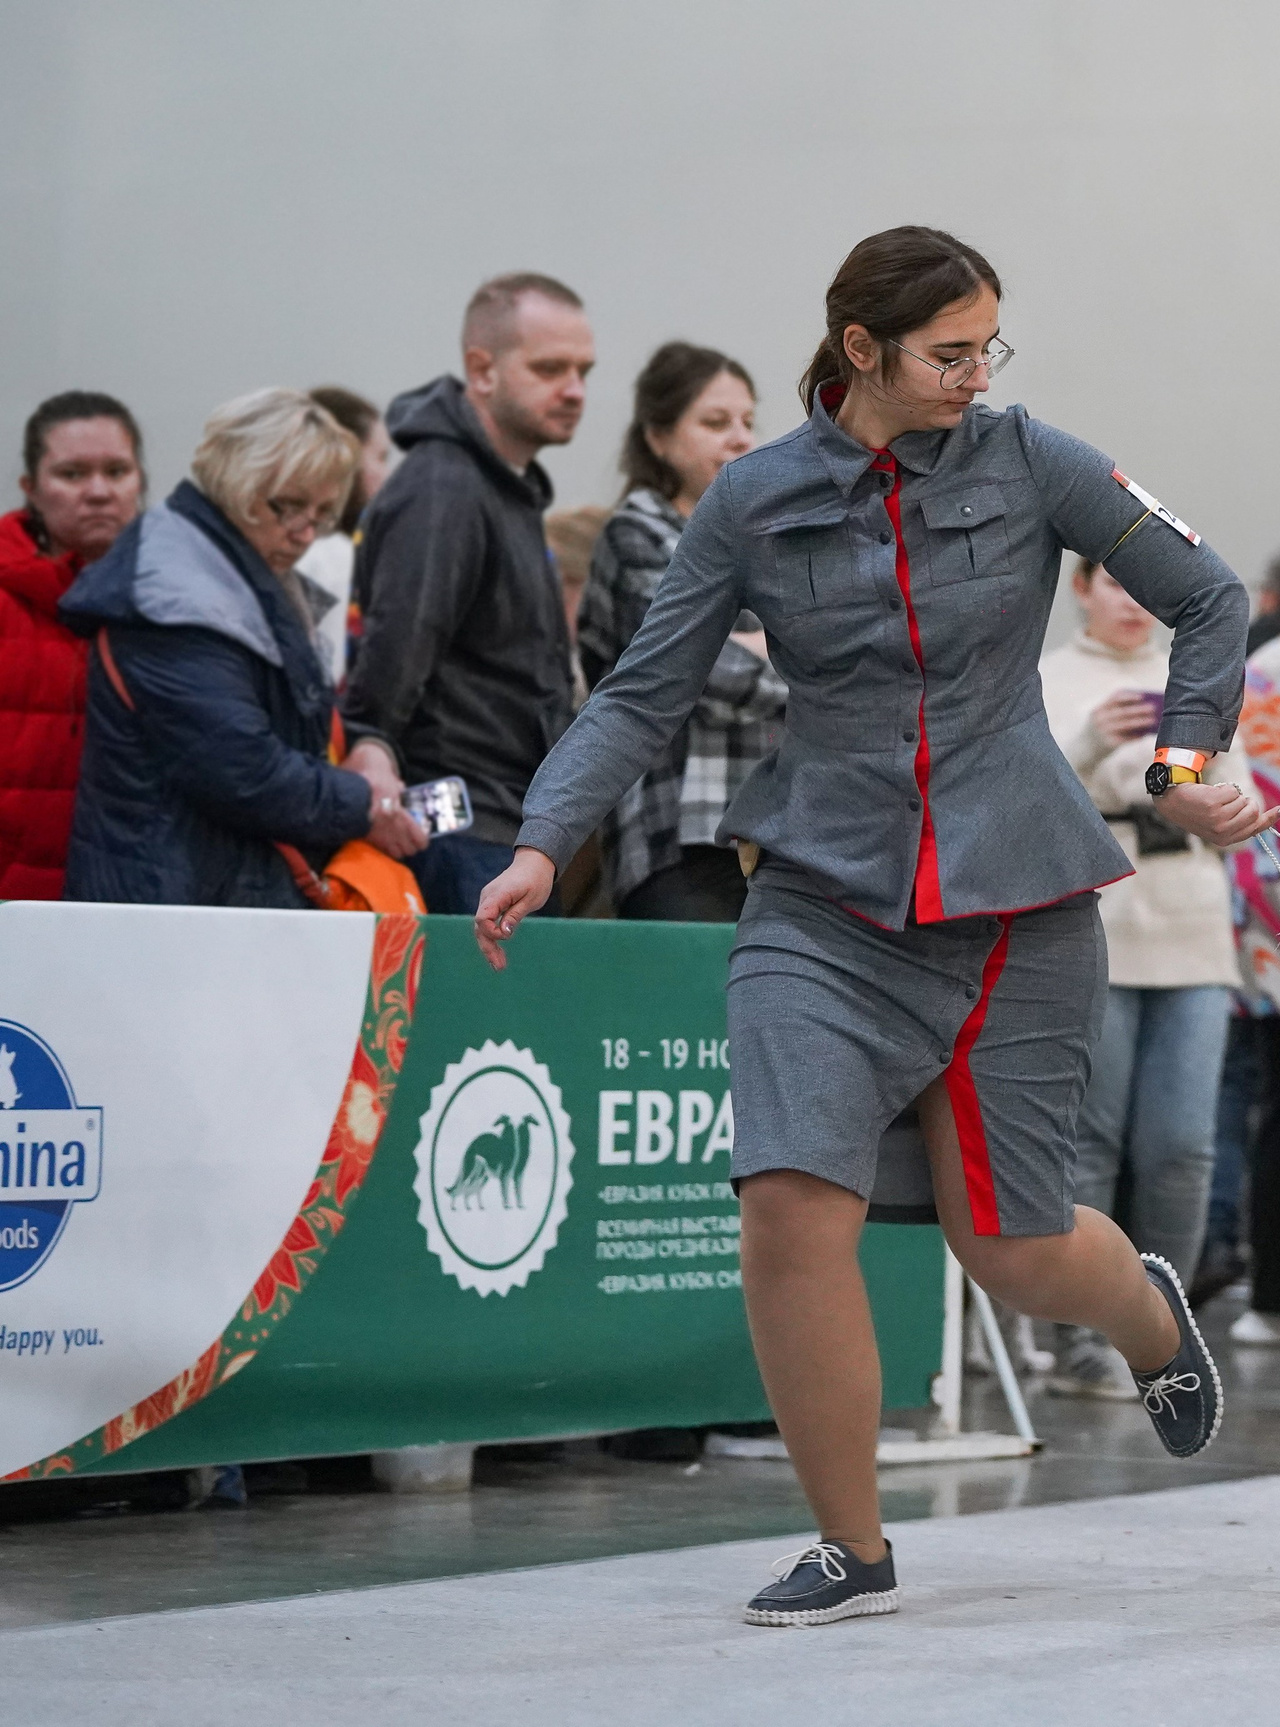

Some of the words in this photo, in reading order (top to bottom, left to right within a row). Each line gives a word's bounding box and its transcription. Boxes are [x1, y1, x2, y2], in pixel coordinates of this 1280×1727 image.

[601, 1038, 630, 1069] 18
[660, 1038, 689, 1069] 19
[598, 1090, 734, 1165] ЕВРА
[63, 1328, 103, 1354] you.
